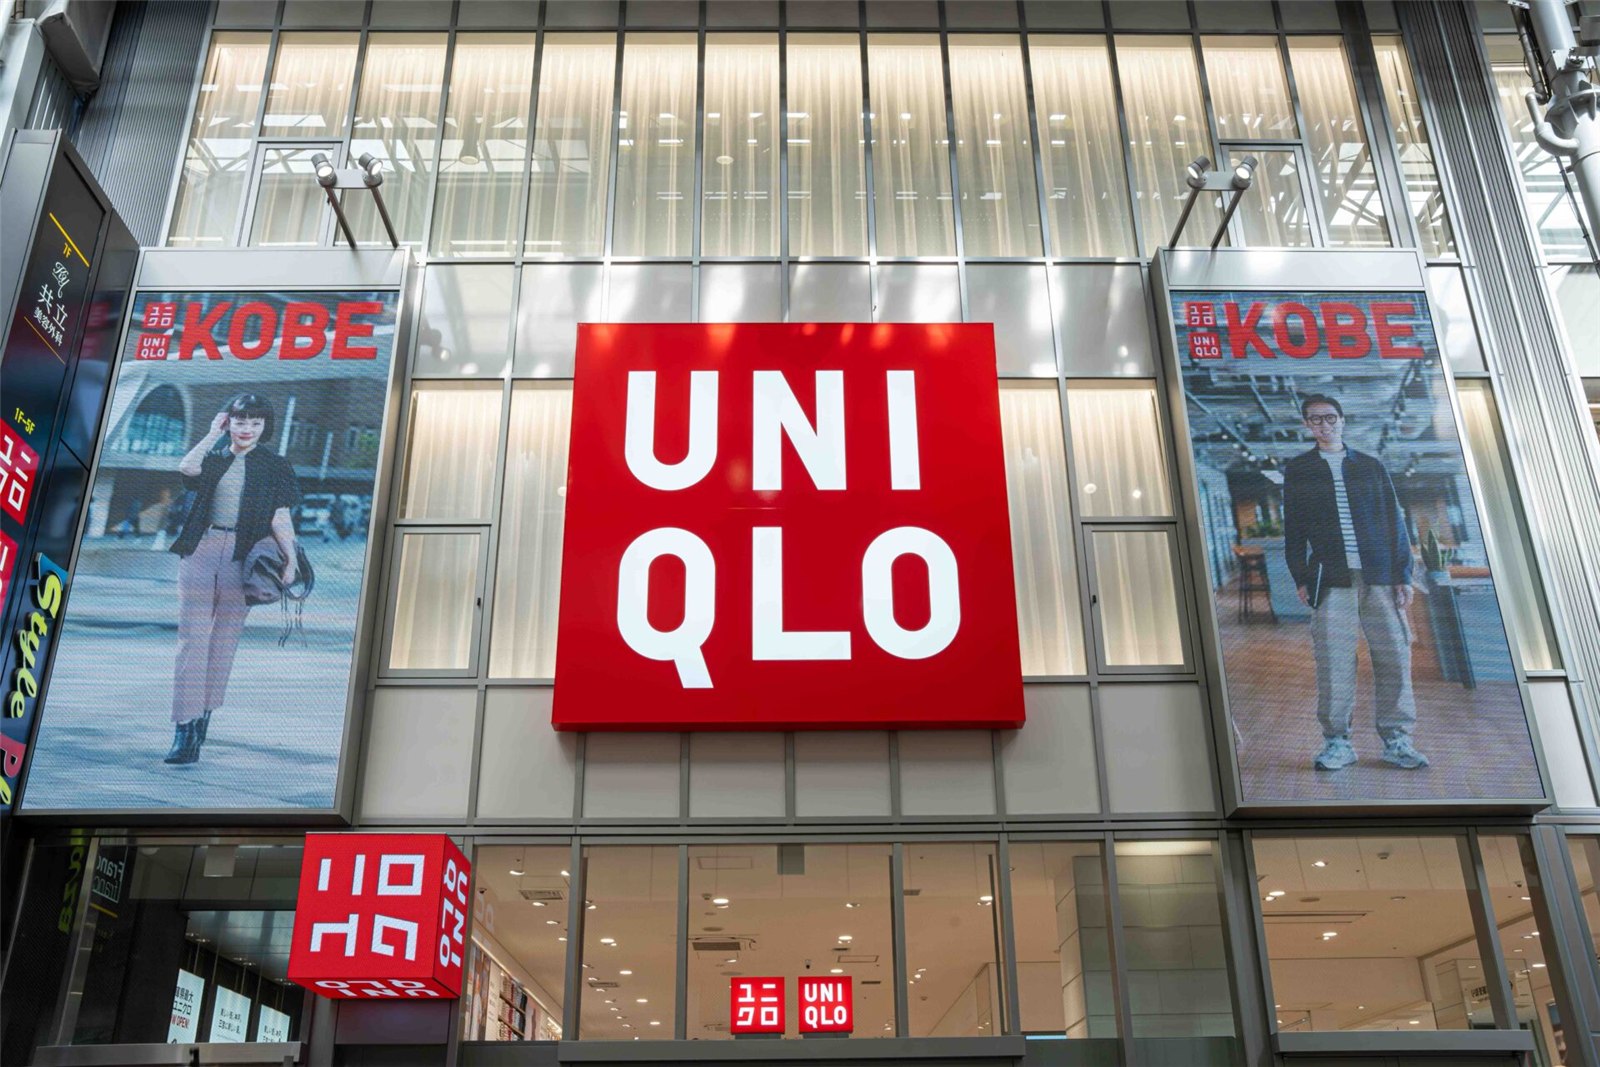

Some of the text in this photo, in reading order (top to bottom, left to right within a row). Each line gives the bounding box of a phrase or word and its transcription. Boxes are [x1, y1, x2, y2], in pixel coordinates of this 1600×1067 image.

[37, 283, 68, 332] 共立
[150, 306, 173, 316] ユニ
[1190, 305, 1210, 315] ユニ
[147, 317, 171, 326] クロ
[1190, 316, 1213, 325] クロ
[1224, 302, 1425, 359] KOBE
[178, 301, 384, 361] KOBE
[1194, 336, 1215, 346] UNI
[143, 338, 165, 347] UNI
[1195, 347, 1219, 357] QLO
[140, 348, 165, 358] QLO
[14, 407, 36, 435] 1F-5F
[625, 370, 921, 491] UNI
[616, 526, 961, 689] QLO
[10, 574, 62, 719] Style
[439, 859, 457, 968] QLO
[450, 871, 468, 968] UNI
[738, 983, 778, 1002] ユニ
[804, 983, 842, 1002] UNI
[736, 1006, 778, 1026] クロ
[804, 1005, 847, 1029] QLO
